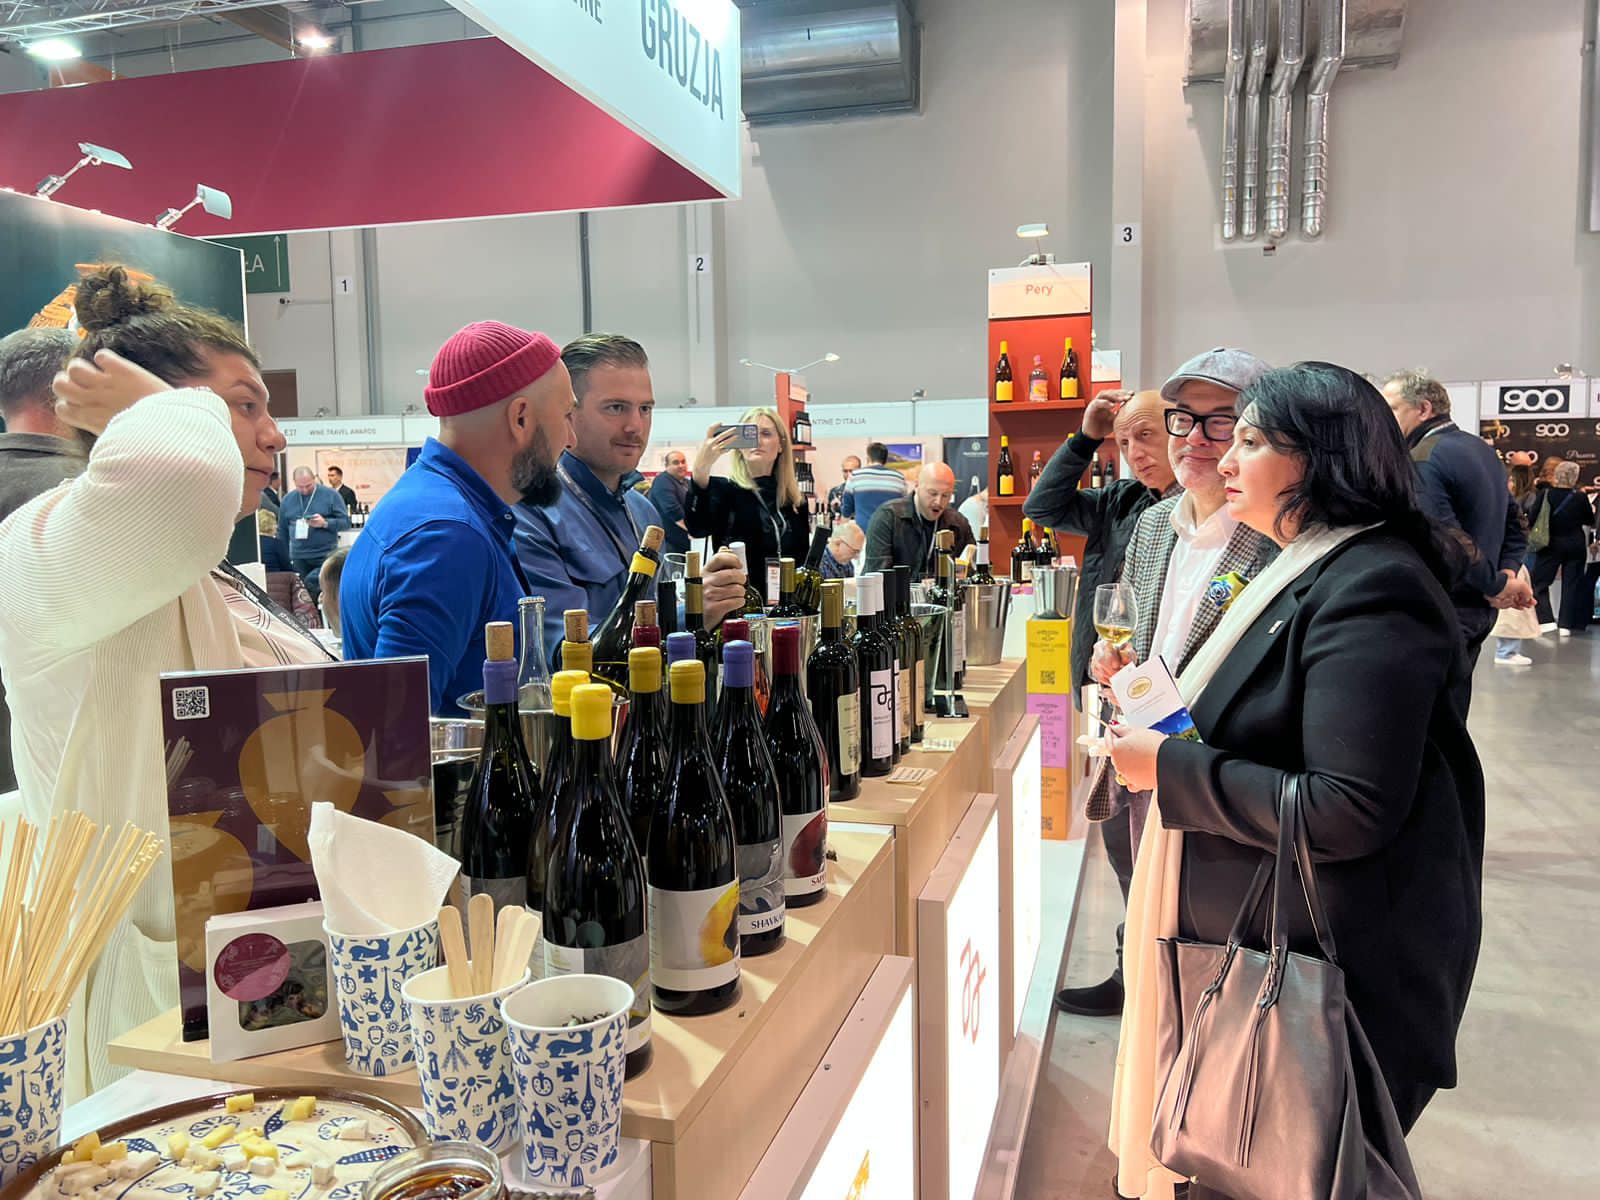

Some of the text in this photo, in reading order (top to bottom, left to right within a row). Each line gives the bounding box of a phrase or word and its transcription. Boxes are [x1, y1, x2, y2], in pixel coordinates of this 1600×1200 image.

[640, 0, 723, 121] GRUZJA
[1122, 226, 1133, 243] 3
[696, 256, 705, 272] 2
[341, 279, 347, 292] 1
[1025, 284, 1054, 297] Pery
[1503, 388, 1565, 412] 900
[1535, 423, 1570, 438] 900
